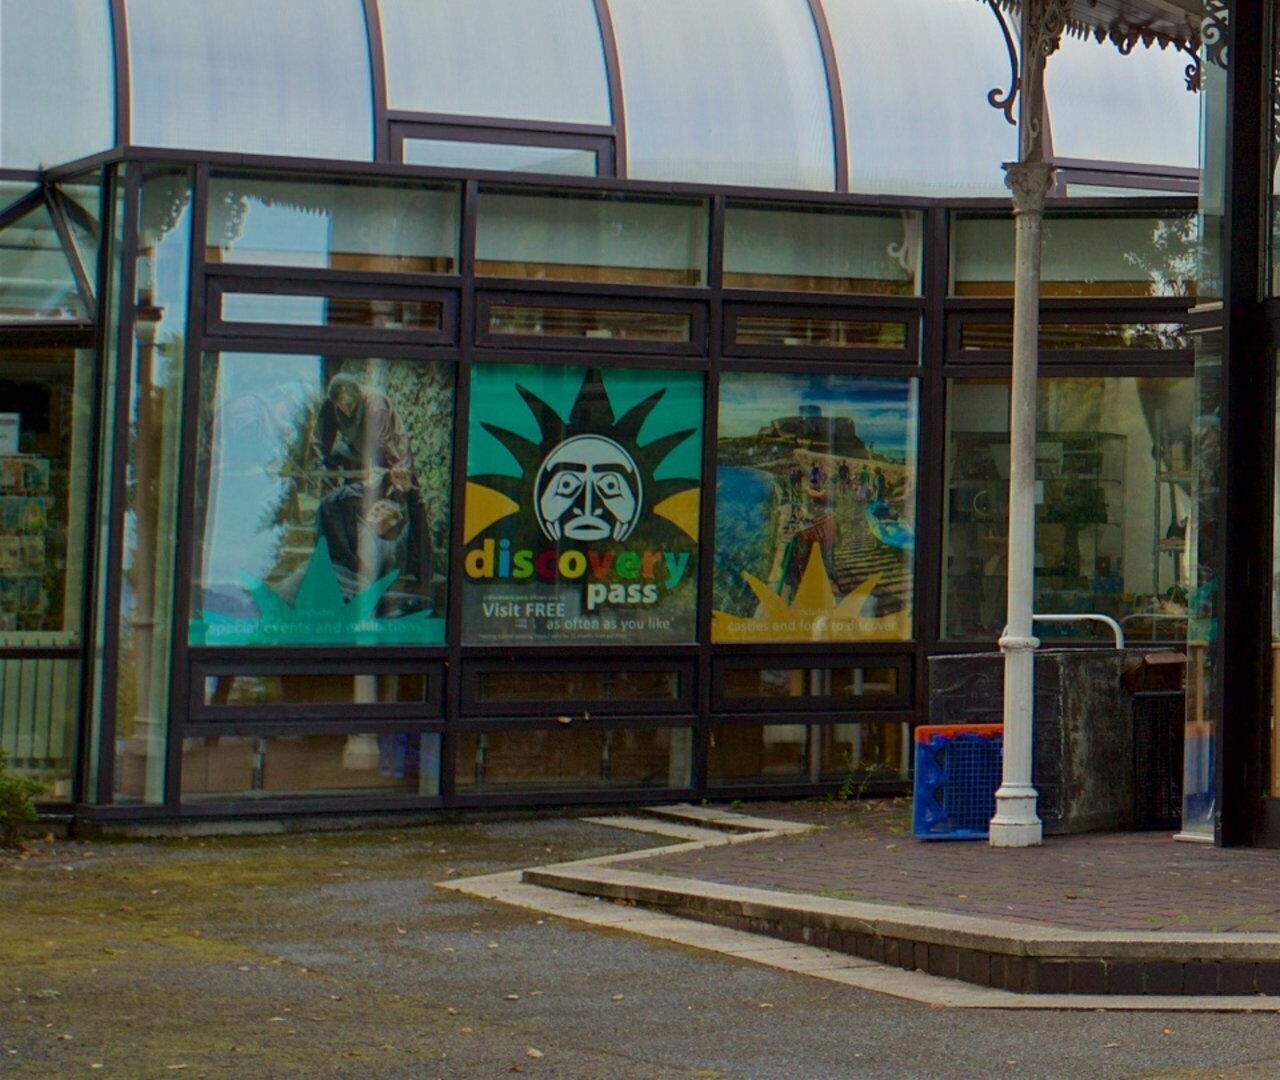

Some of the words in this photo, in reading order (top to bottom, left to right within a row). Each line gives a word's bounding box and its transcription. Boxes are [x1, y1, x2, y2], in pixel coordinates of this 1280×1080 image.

[465, 538, 691, 590] discovery
[587, 583, 658, 610] pass
[482, 603, 520, 618] Visit
[525, 603, 565, 618] FREE
[264, 621, 314, 634] events
[316, 620, 342, 634] and
[546, 620, 561, 631] as
[564, 616, 600, 631] often
[603, 620, 617, 631] as
[621, 620, 644, 634] you
[727, 620, 769, 633] castles
[773, 620, 796, 633] and
